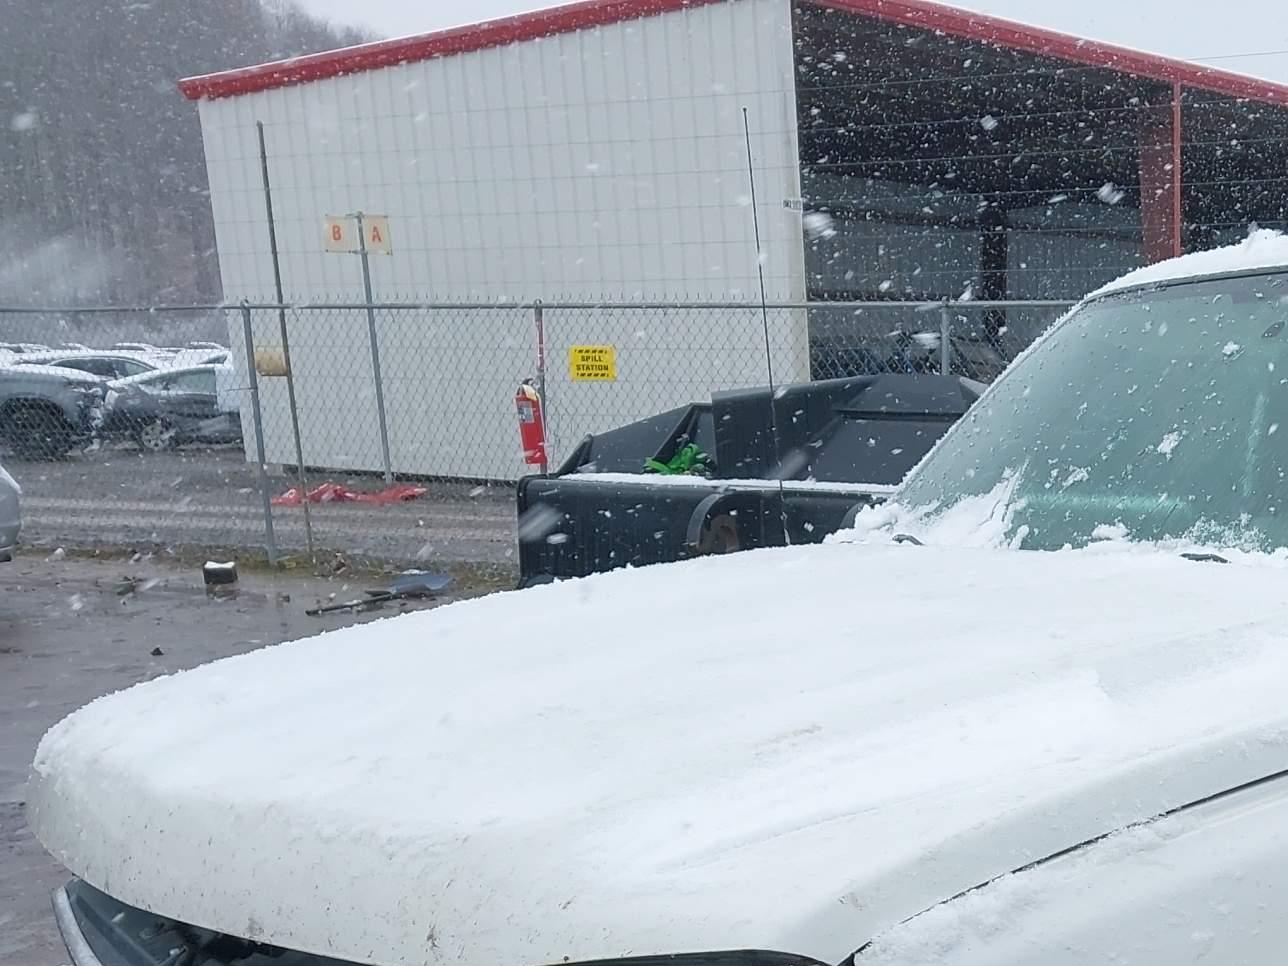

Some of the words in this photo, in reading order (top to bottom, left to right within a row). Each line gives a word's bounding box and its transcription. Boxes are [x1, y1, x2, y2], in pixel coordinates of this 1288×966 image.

[332, 224, 342, 241] B
[371, 225, 382, 242] A
[581, 354, 603, 363] SPILL
